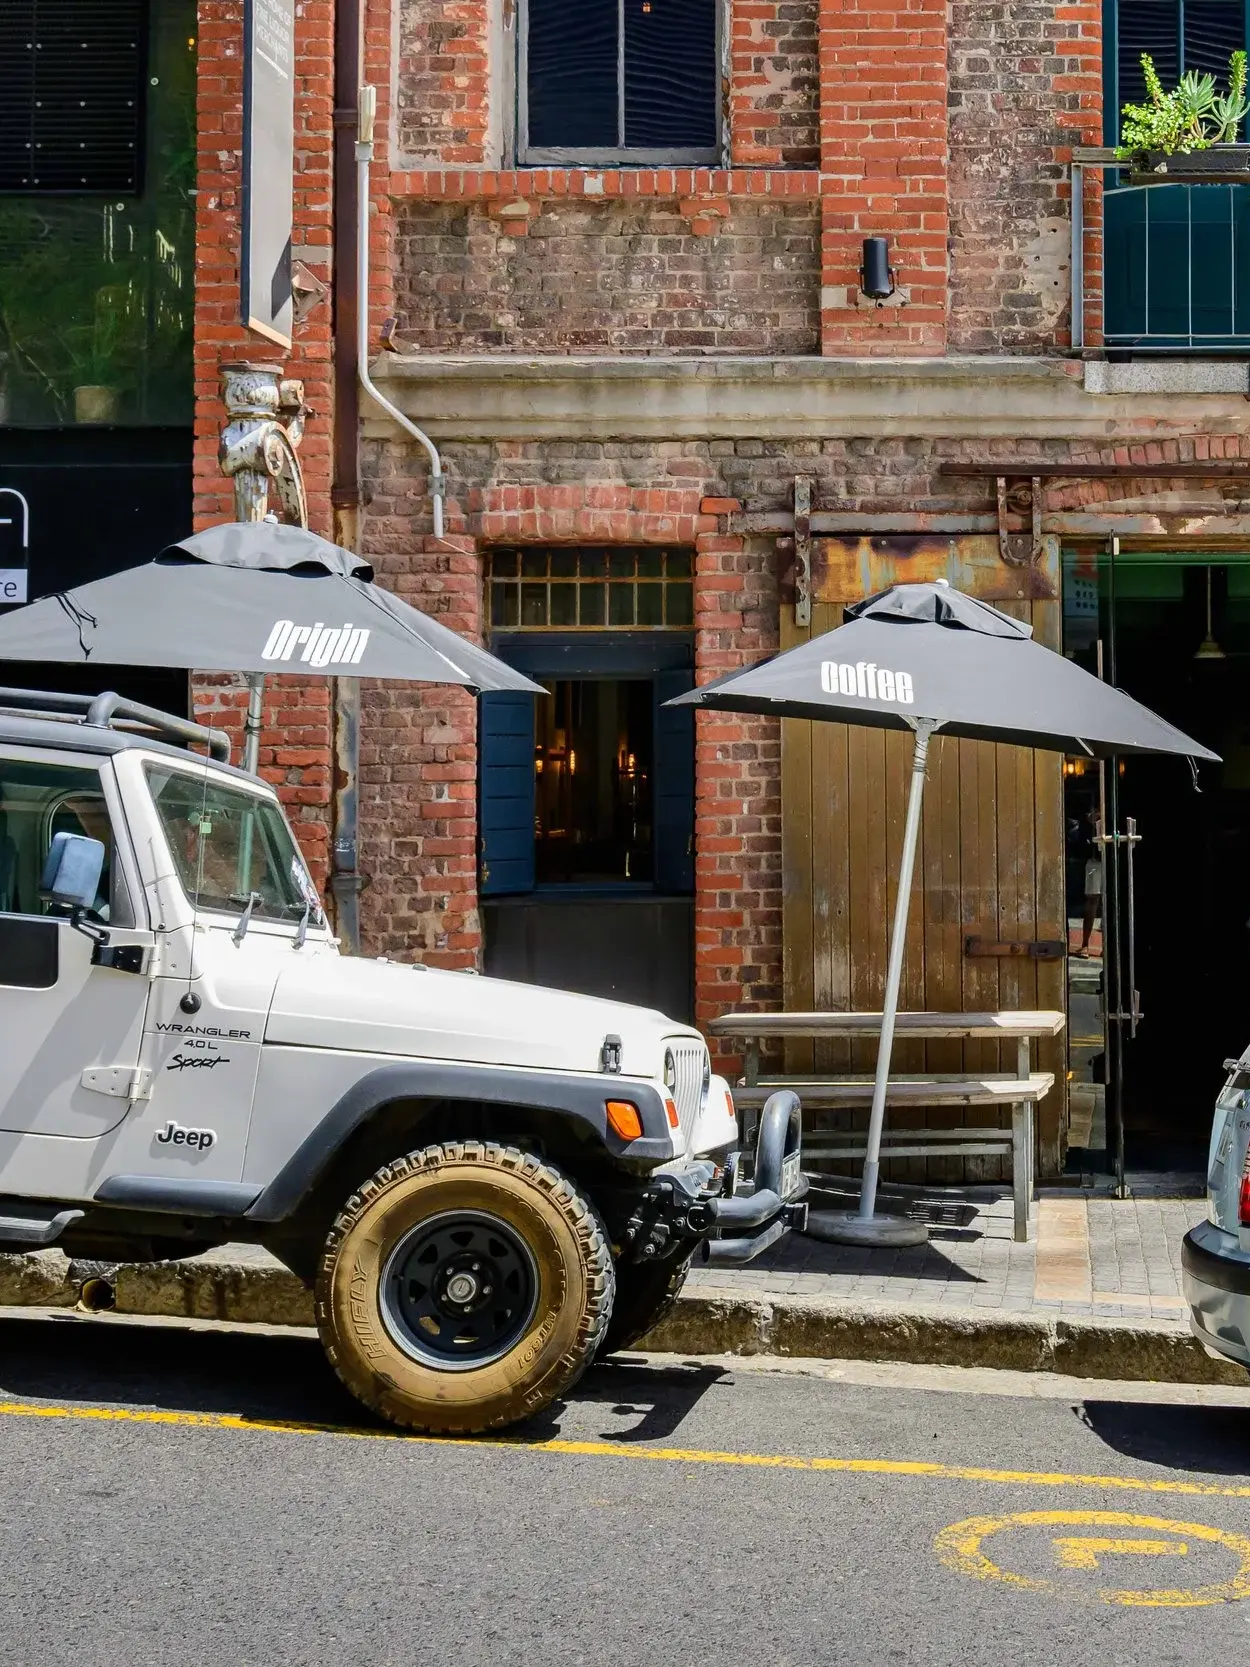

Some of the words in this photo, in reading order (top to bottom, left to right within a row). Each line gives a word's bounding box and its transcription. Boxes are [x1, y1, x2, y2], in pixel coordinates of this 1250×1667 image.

[261, 620, 371, 668] Origin
[156, 1022, 251, 1039] WRANGLER
[157, 1124, 215, 1151] Jeep
